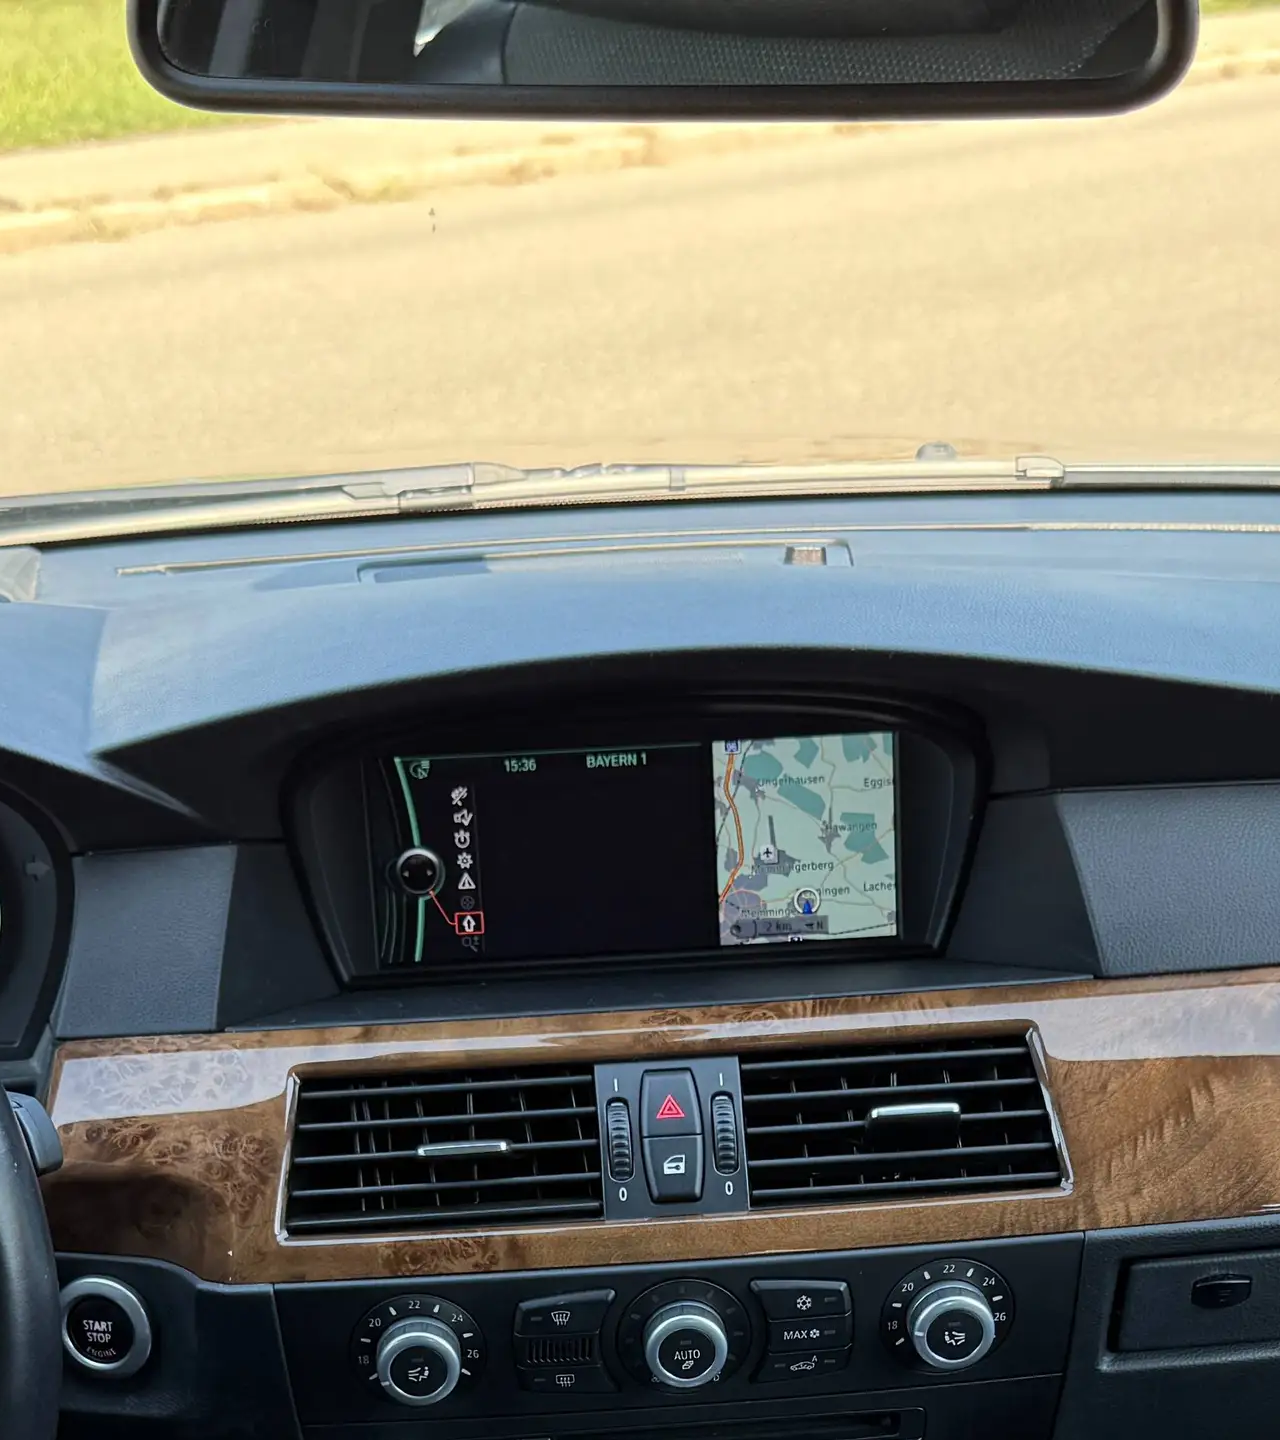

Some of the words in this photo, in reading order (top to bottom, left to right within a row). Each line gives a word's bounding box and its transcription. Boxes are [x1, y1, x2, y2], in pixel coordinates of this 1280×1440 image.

[586, 753, 636, 768] BAYERN
[640, 752, 647, 766] 1
[505, 759, 536, 772] 15:36
[943, 1264, 955, 1274] 22
[901, 1282, 914, 1292] 20
[983, 1277, 996, 1287] 24
[409, 1300, 420, 1310] 22
[451, 1313, 464, 1323] 24
[994, 1312, 1006, 1322] 26
[83, 1319, 113, 1332] START
[369, 1318, 381, 1328] 20
[887, 1321, 898, 1331] 18
[87, 1332, 111, 1343] STOP
[783, 1330, 808, 1340] MAX
[86, 1346, 117, 1358] ENGINE
[467, 1349, 479, 1359] 26
[674, 1349, 701, 1360] AUTO
[358, 1355, 370, 1365] 18
